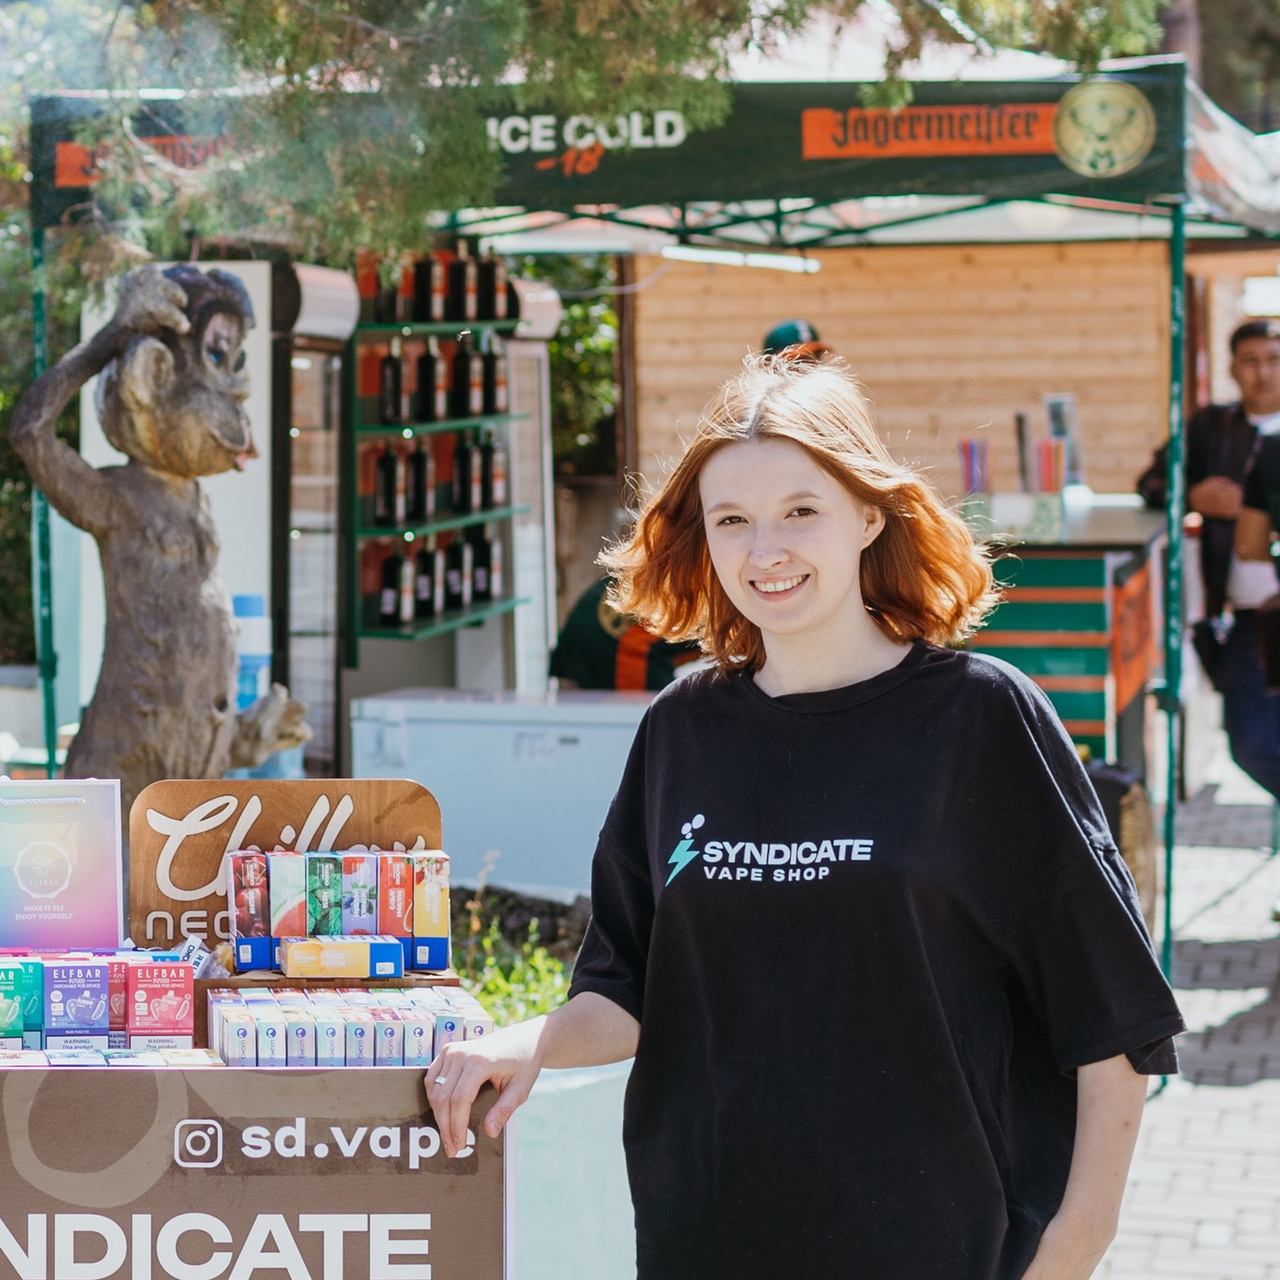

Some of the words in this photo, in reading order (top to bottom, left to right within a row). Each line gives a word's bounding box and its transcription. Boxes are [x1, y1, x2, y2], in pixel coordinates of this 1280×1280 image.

[563, 110, 687, 149] COLD
[703, 839, 874, 865] SYNDICATE
[703, 867, 763, 882] VAPE
[773, 866, 830, 882] SHOP
[53, 969, 101, 979] ELFBAR
[137, 969, 185, 978] ELFBAR
